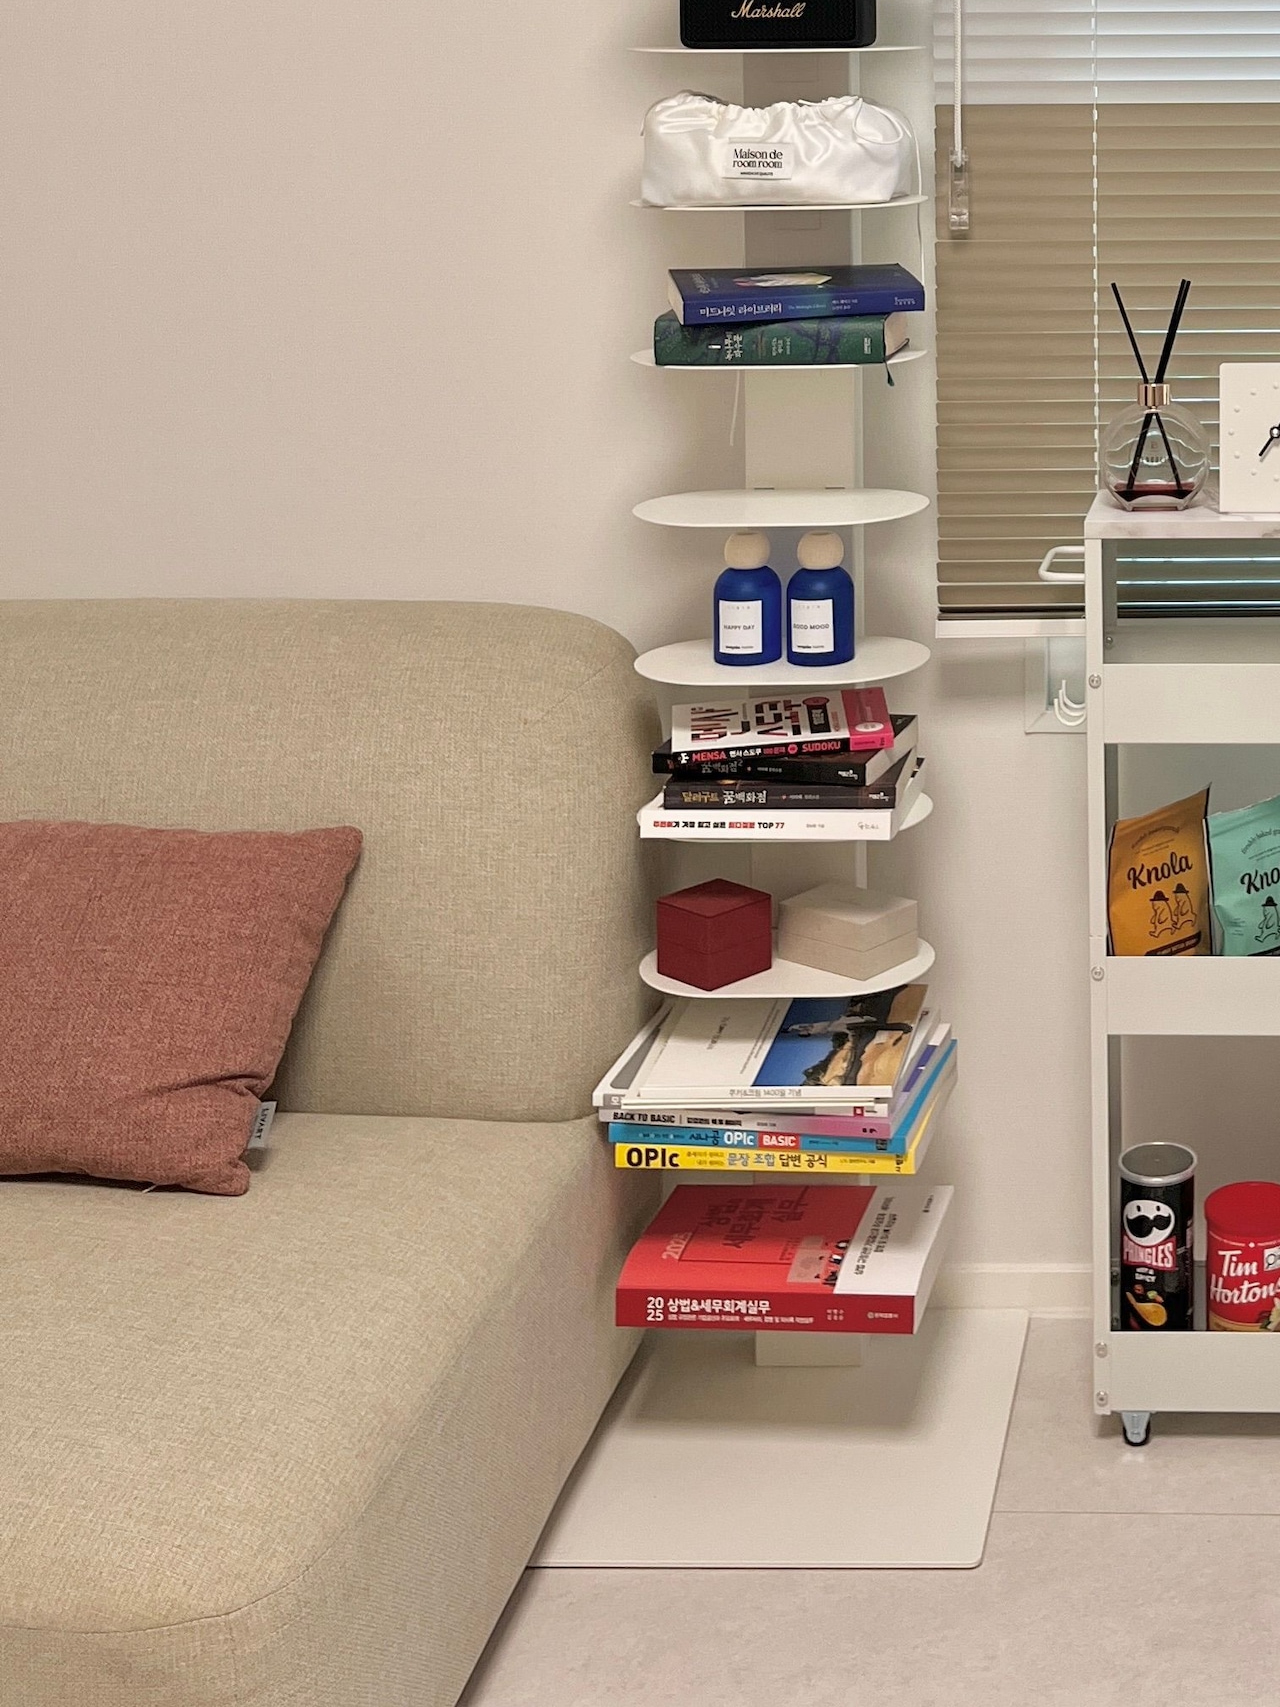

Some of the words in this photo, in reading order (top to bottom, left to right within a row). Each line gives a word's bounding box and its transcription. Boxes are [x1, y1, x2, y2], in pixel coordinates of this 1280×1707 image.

[733, 148, 768, 159] Maison
[769, 149, 783, 159] de
[732, 160, 757, 168] room
[757, 160, 783, 169] room
[700, 305, 736, 318] 미드나잇
[738, 302, 782, 315] 라이브러리
[802, 740, 841, 753] SUDOKU
[692, 751, 727, 762] MENSA
[722, 789, 767, 805] 꿈백화점
[757, 821, 774, 829] TOP
[775, 821, 785, 829] 77
[1127, 851, 1194, 890] Knola
[613, 1112, 635, 1121] BACK
[637, 1114, 648, 1122] TO
[650, 1114, 676, 1124] BASIC
[723, 1131, 755, 1146] OPIc
[762, 1134, 796, 1147] BASIC
[626, 1147, 680, 1168] OPIc
[727, 1152, 750, 1167] 문장
[779, 1153, 802, 1168] 답변
[804, 1154, 828, 1169] 공식
[1217, 1250, 1258, 1277] Tim
[667, 1298, 771, 1314] 상법&세무회계실무
